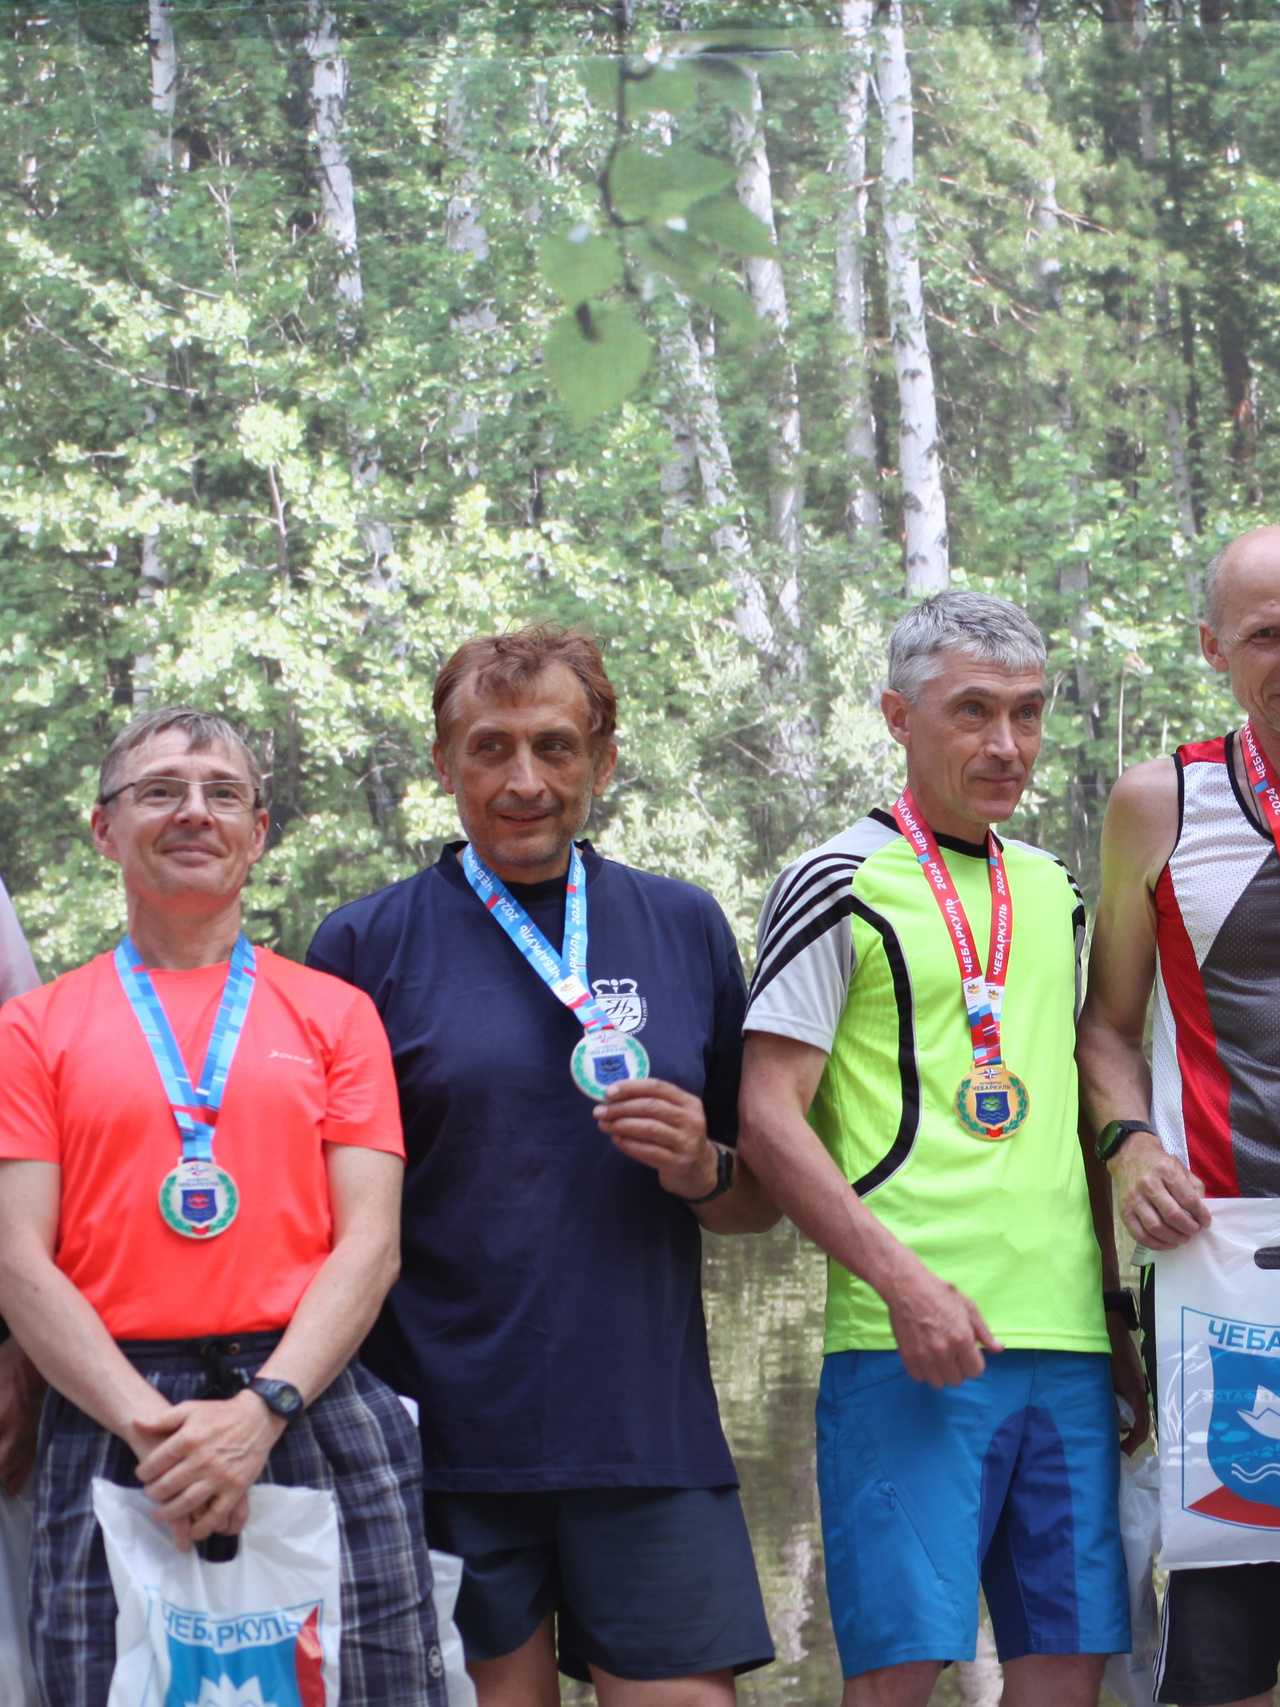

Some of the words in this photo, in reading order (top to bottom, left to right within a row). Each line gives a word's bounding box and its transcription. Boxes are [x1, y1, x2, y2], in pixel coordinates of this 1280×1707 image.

[927, 862, 947, 891] 2024
[997, 868, 1006, 897] 2024
[498, 897, 520, 922] 2024
[571, 897, 580, 926] 2024
[519, 924, 561, 979] ЧЕБАРКУЛЬ
[944, 898, 973, 973] ЧЕБАРКУЛЬ
[993, 903, 1008, 976] ЧЕБАРКУЛЬ
[163, 1606, 303, 1648] ЧЕБРКУЛЬ
